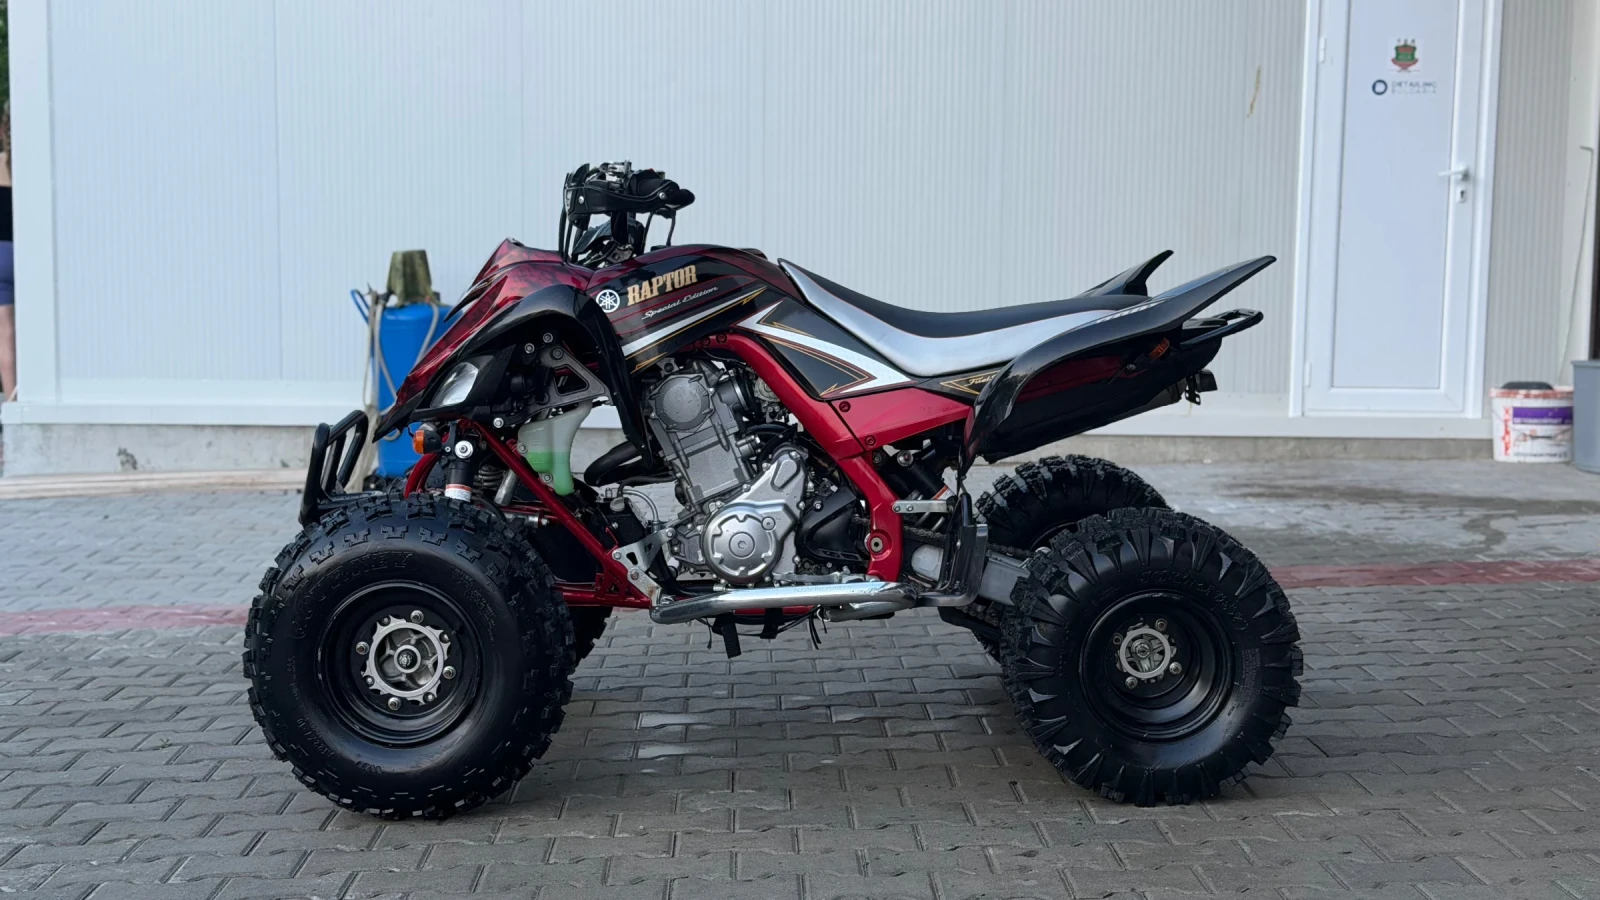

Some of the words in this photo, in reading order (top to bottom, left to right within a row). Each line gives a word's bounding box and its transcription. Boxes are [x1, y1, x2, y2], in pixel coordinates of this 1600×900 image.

[627, 265, 698, 306] RAPTOR
[641, 300, 682, 320] Special
[682, 286, 719, 303] Edition
[963, 376, 991, 387] Fuel
